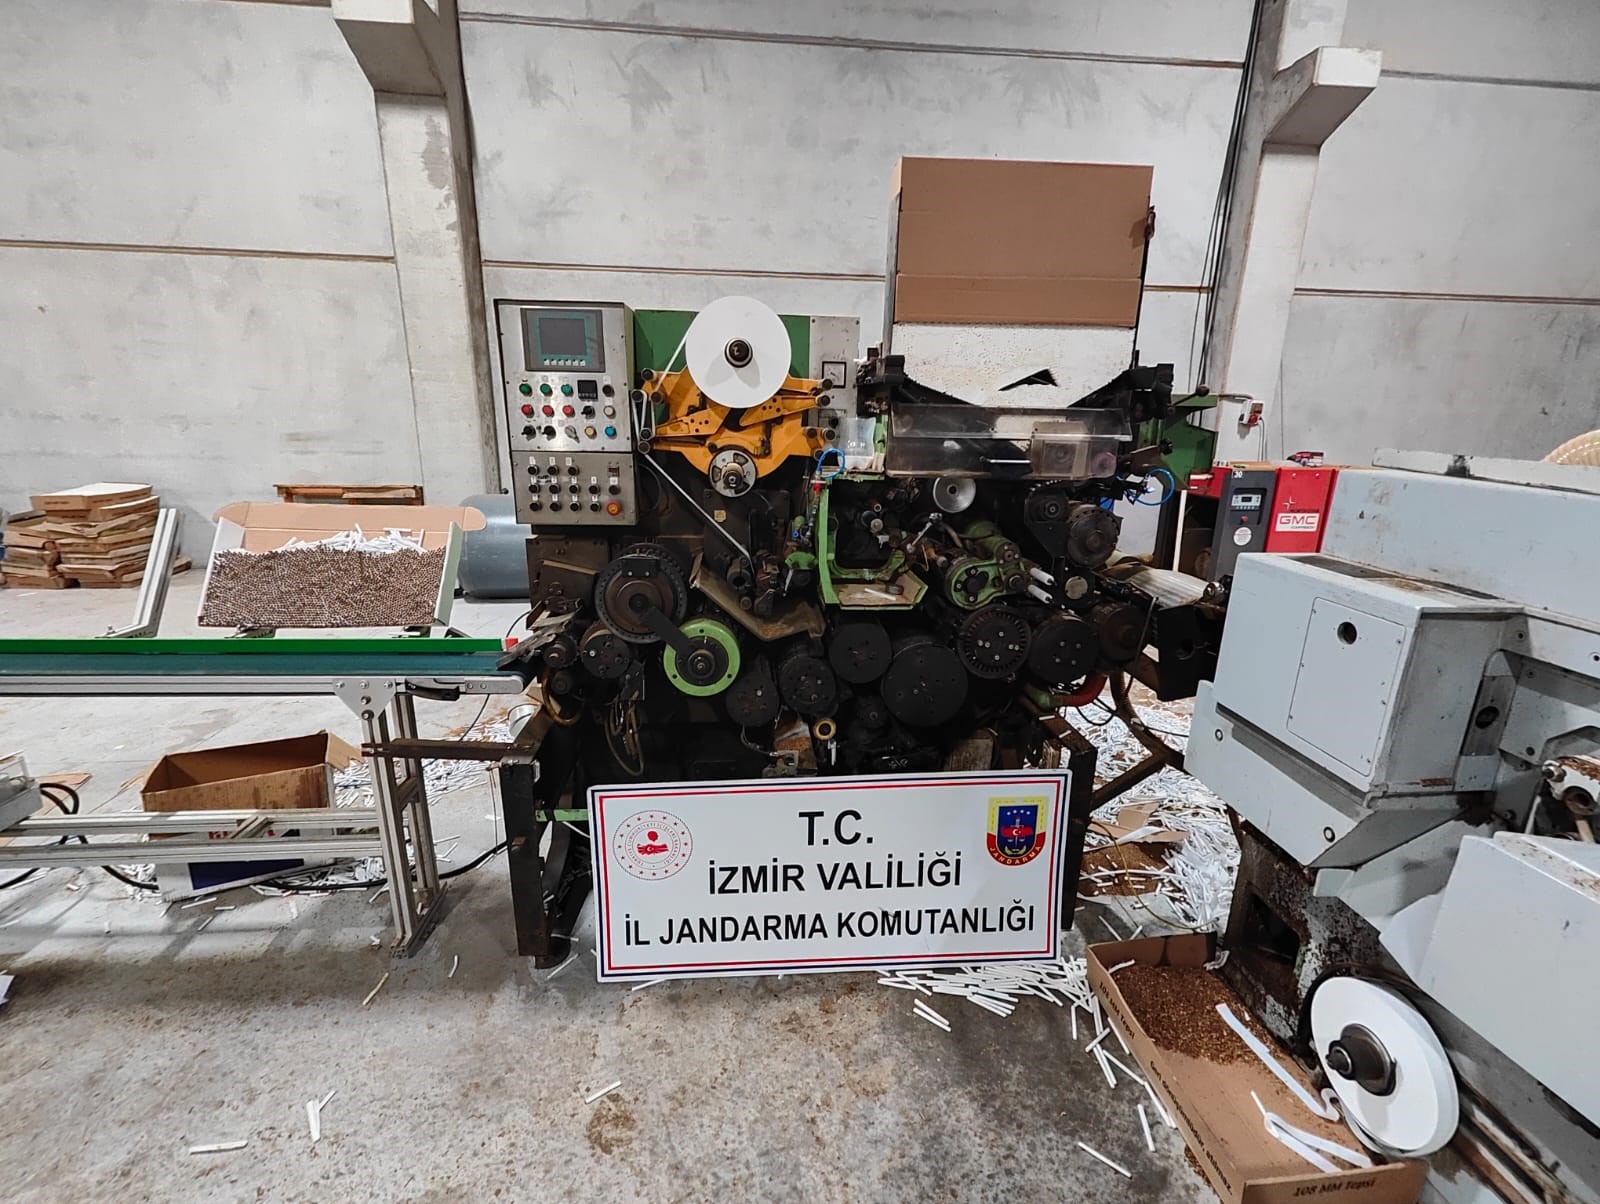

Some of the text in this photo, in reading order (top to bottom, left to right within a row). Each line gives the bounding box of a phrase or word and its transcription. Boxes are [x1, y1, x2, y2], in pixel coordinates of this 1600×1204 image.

[1279, 515, 1317, 525] GMC
[798, 809, 874, 846] T.C.
[989, 846, 1041, 865] JANDARMA
[709, 851, 961, 895] İZMİR VALİLİĞİ
[625, 899, 1034, 946] İL JANDARMA KOMUTANLIĞI
[1293, 1177, 1377, 1197] 108 MM Tepsi
